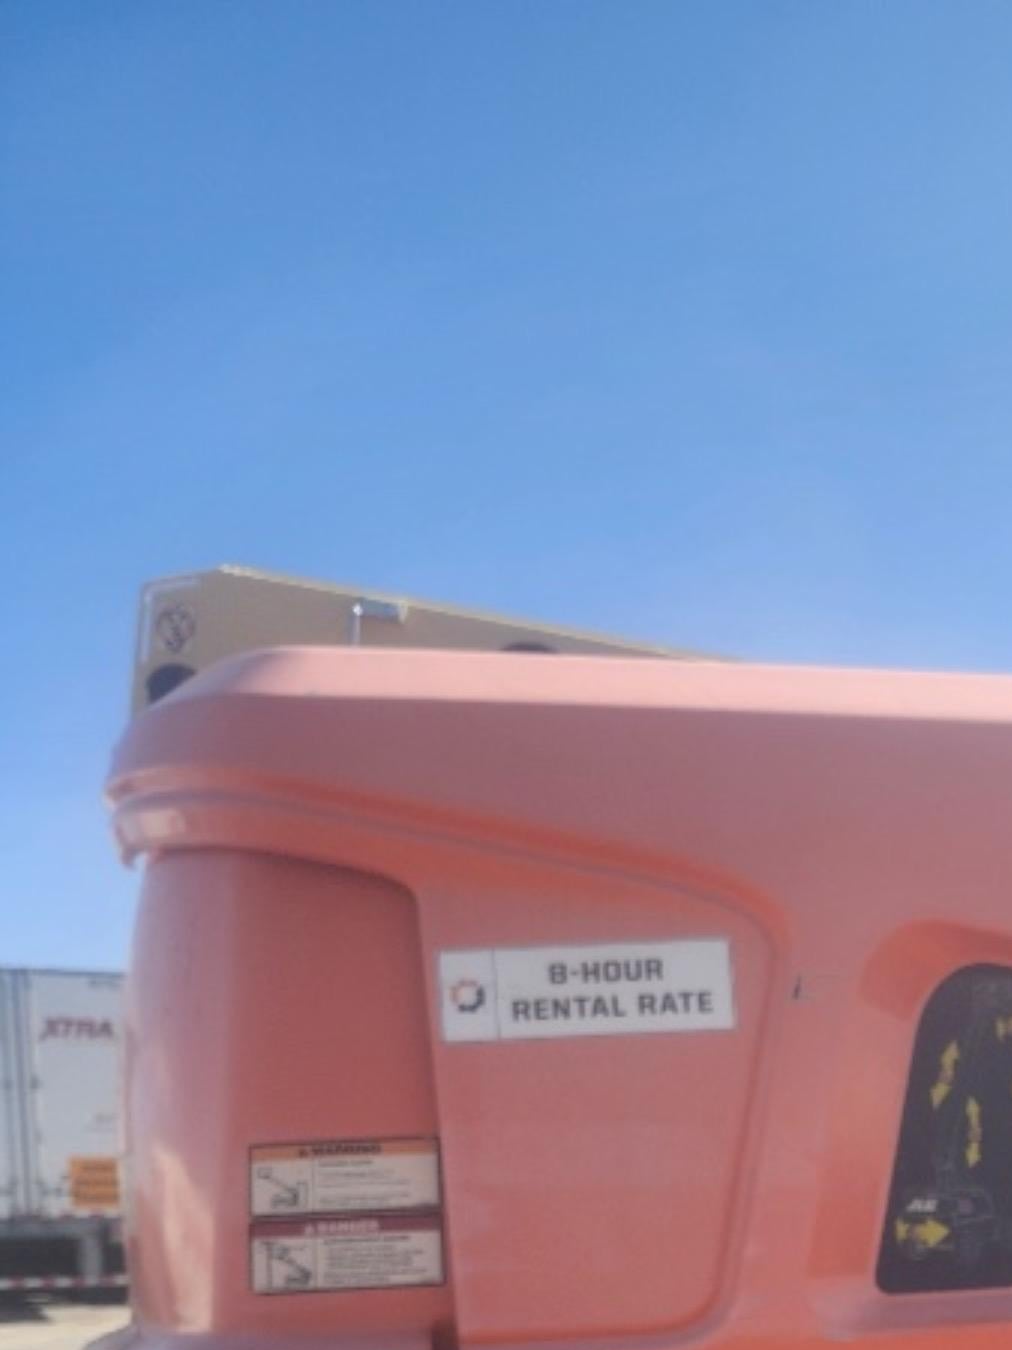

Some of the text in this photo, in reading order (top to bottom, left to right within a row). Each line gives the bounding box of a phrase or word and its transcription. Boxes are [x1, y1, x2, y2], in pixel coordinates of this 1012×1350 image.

[546, 957, 665, 986] 8-HOUR
[511, 990, 715, 1023] RENTAL RATE
